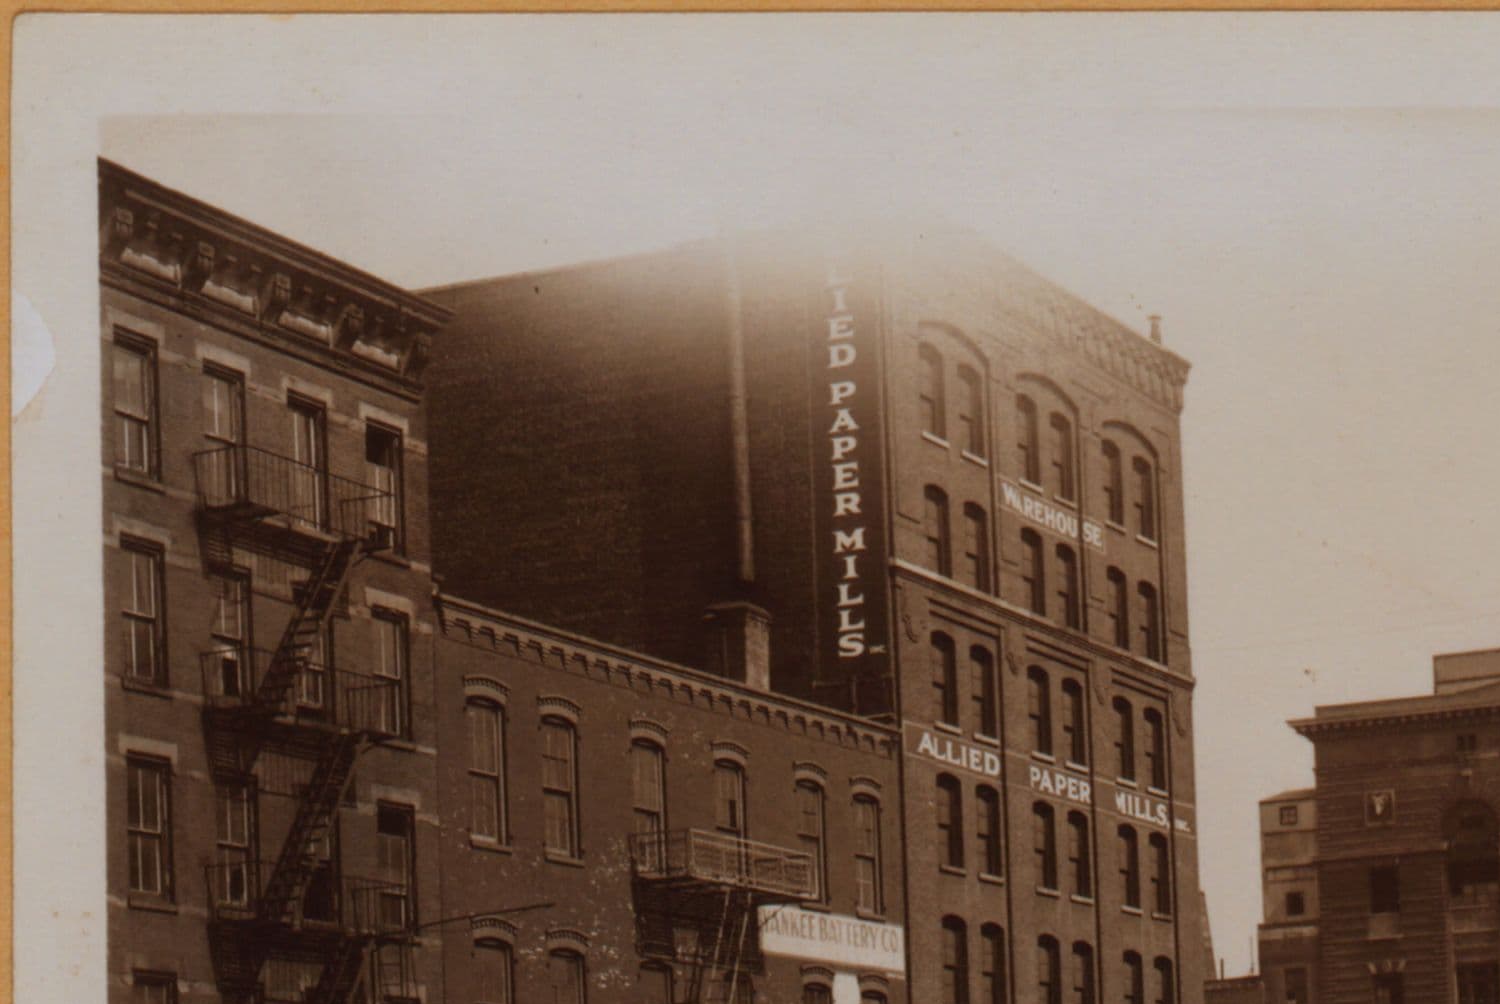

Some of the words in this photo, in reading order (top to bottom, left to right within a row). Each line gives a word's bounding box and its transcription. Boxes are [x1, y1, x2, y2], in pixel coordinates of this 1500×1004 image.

[829, 381, 861, 517] PAPER
[1001, 482, 1102, 548] WAREHOUSE
[834, 527, 867, 658] MILLS
[917, 732, 1000, 776] ALLIED
[1030, 766, 1091, 802] PAPER
[819, 916, 879, 950] BATTERY
